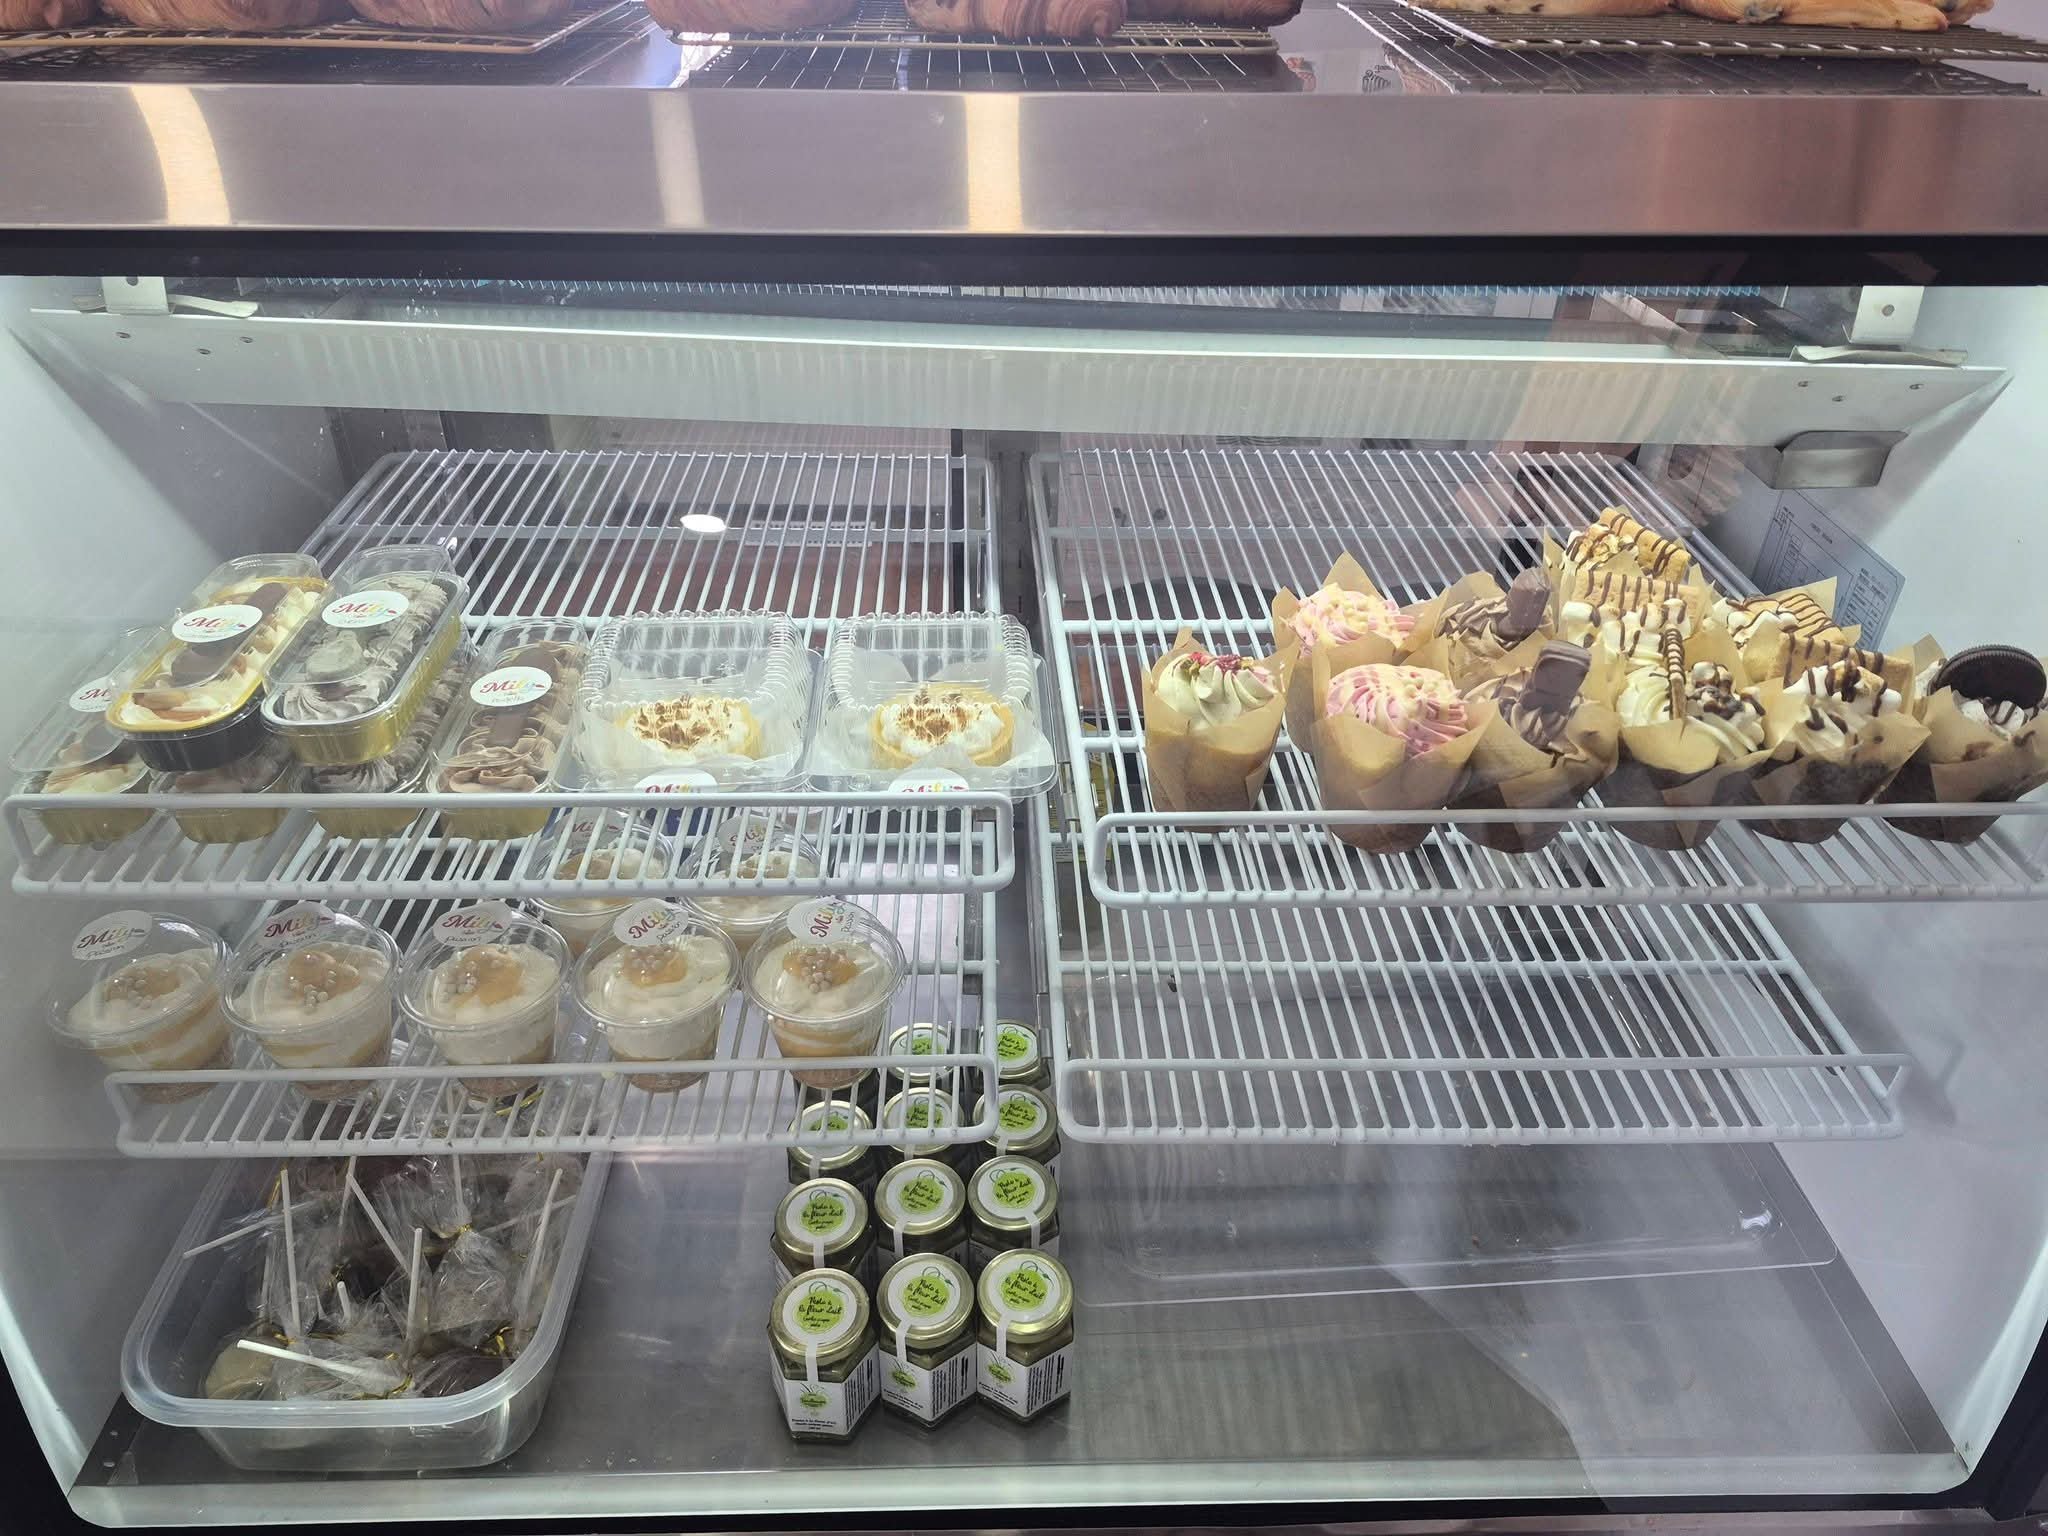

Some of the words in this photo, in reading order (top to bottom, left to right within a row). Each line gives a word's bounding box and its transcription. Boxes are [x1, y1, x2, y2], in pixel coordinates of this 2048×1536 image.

[332, 602, 387, 618] Mily
[479, 679, 537, 696] Mily
[264, 912, 320, 938] Mily
[442, 913, 496, 933] Mily
[629, 909, 674, 938] Mily
[810, 904, 846, 937] Mily
[77, 927, 135, 949] Mily
